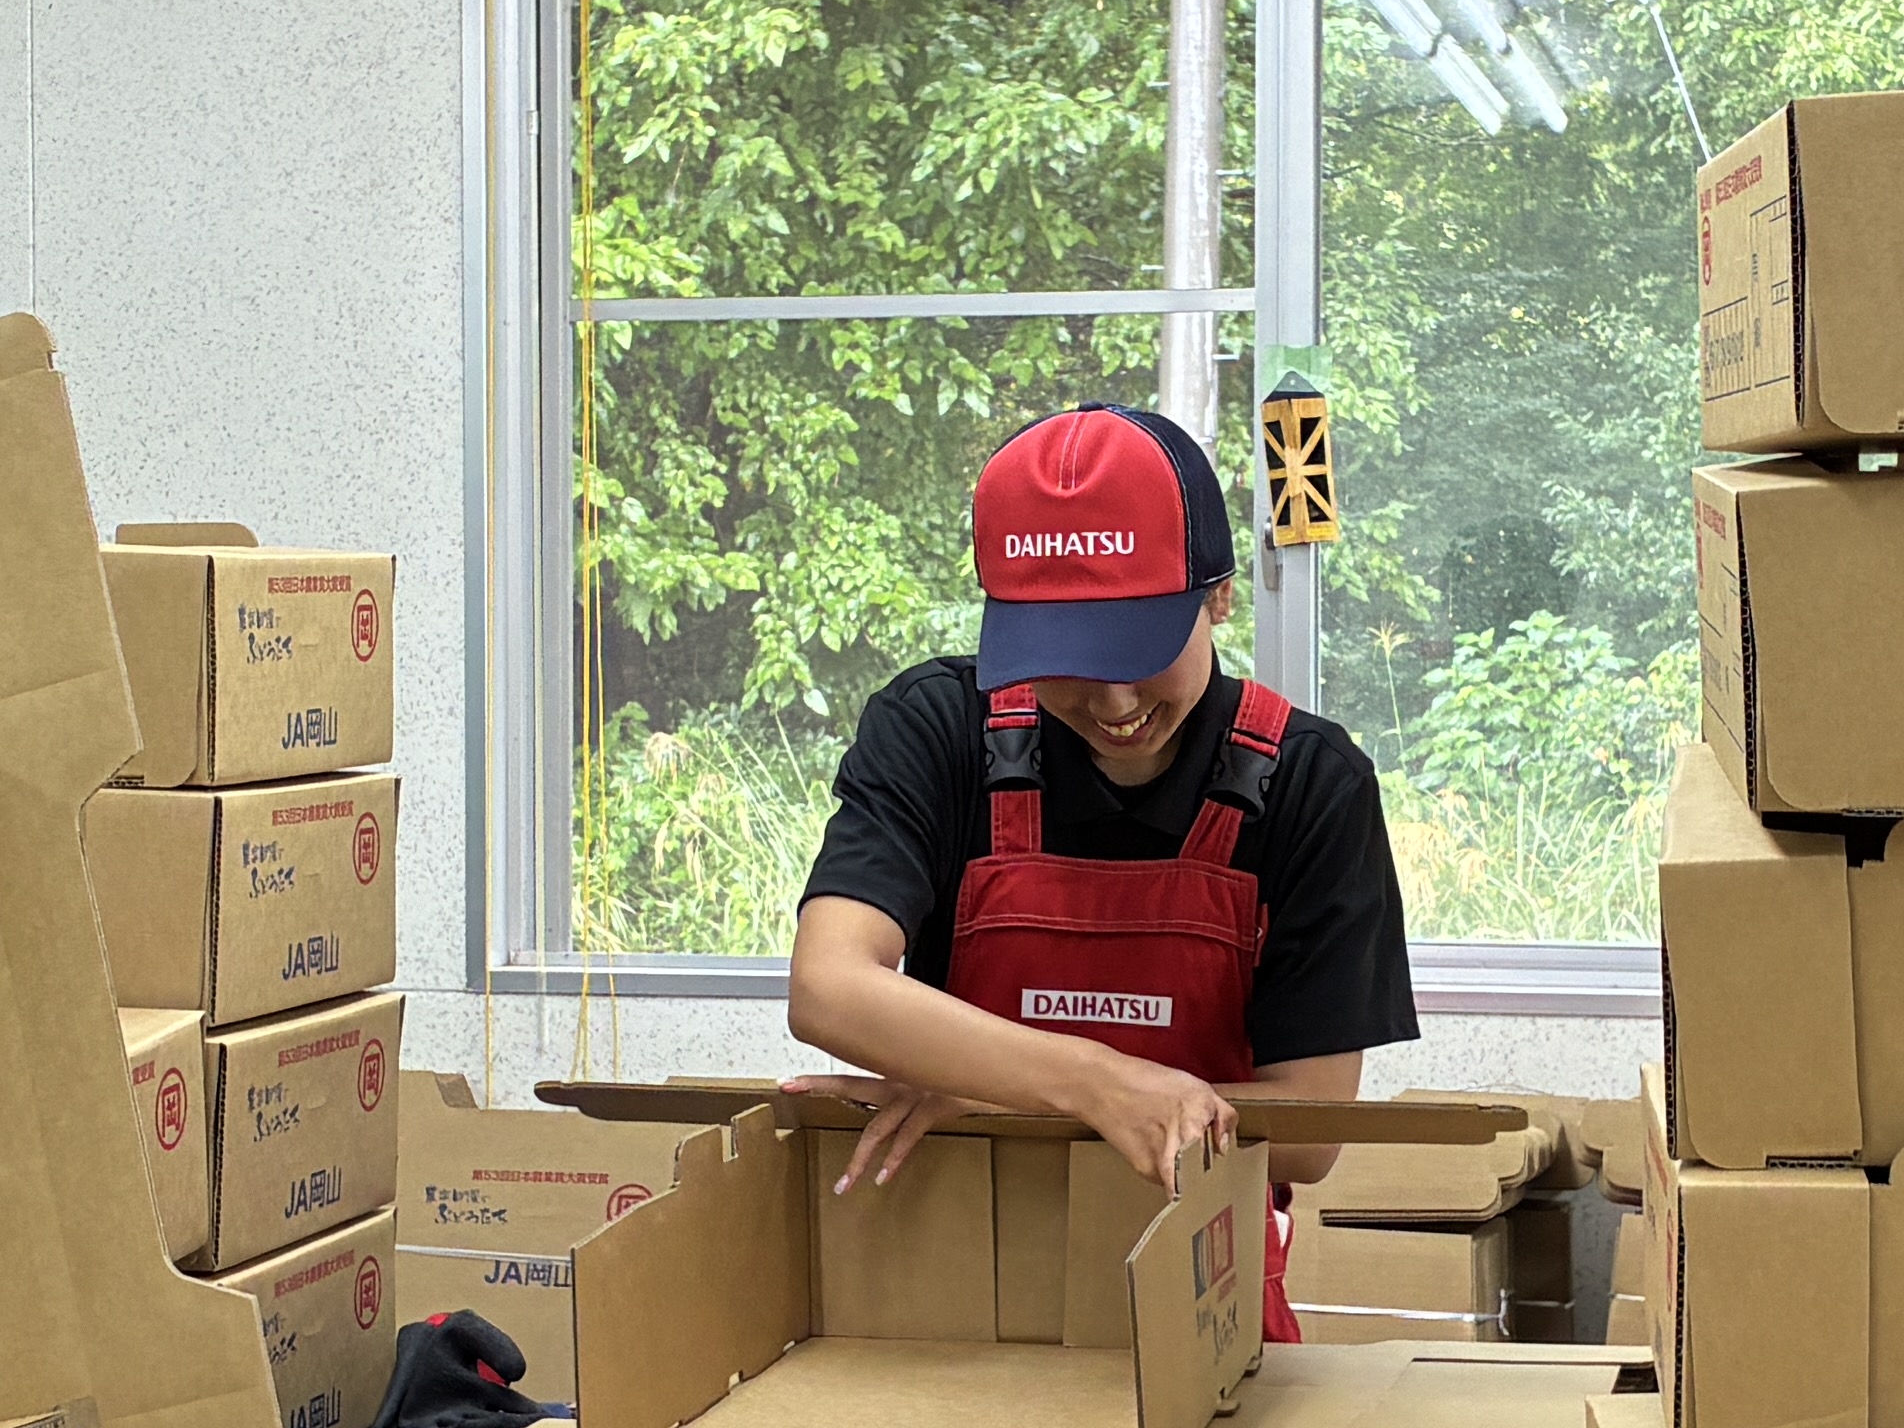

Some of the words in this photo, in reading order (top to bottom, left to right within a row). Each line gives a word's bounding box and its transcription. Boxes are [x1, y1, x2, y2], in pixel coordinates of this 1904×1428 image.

[1005, 531, 1134, 559] DAIHATSU
[282, 706, 338, 750] JA岡山
[282, 930, 339, 980] JA岡山
[1033, 994, 1160, 1021] DAIHATSU
[285, 1165, 342, 1219] JA岡山
